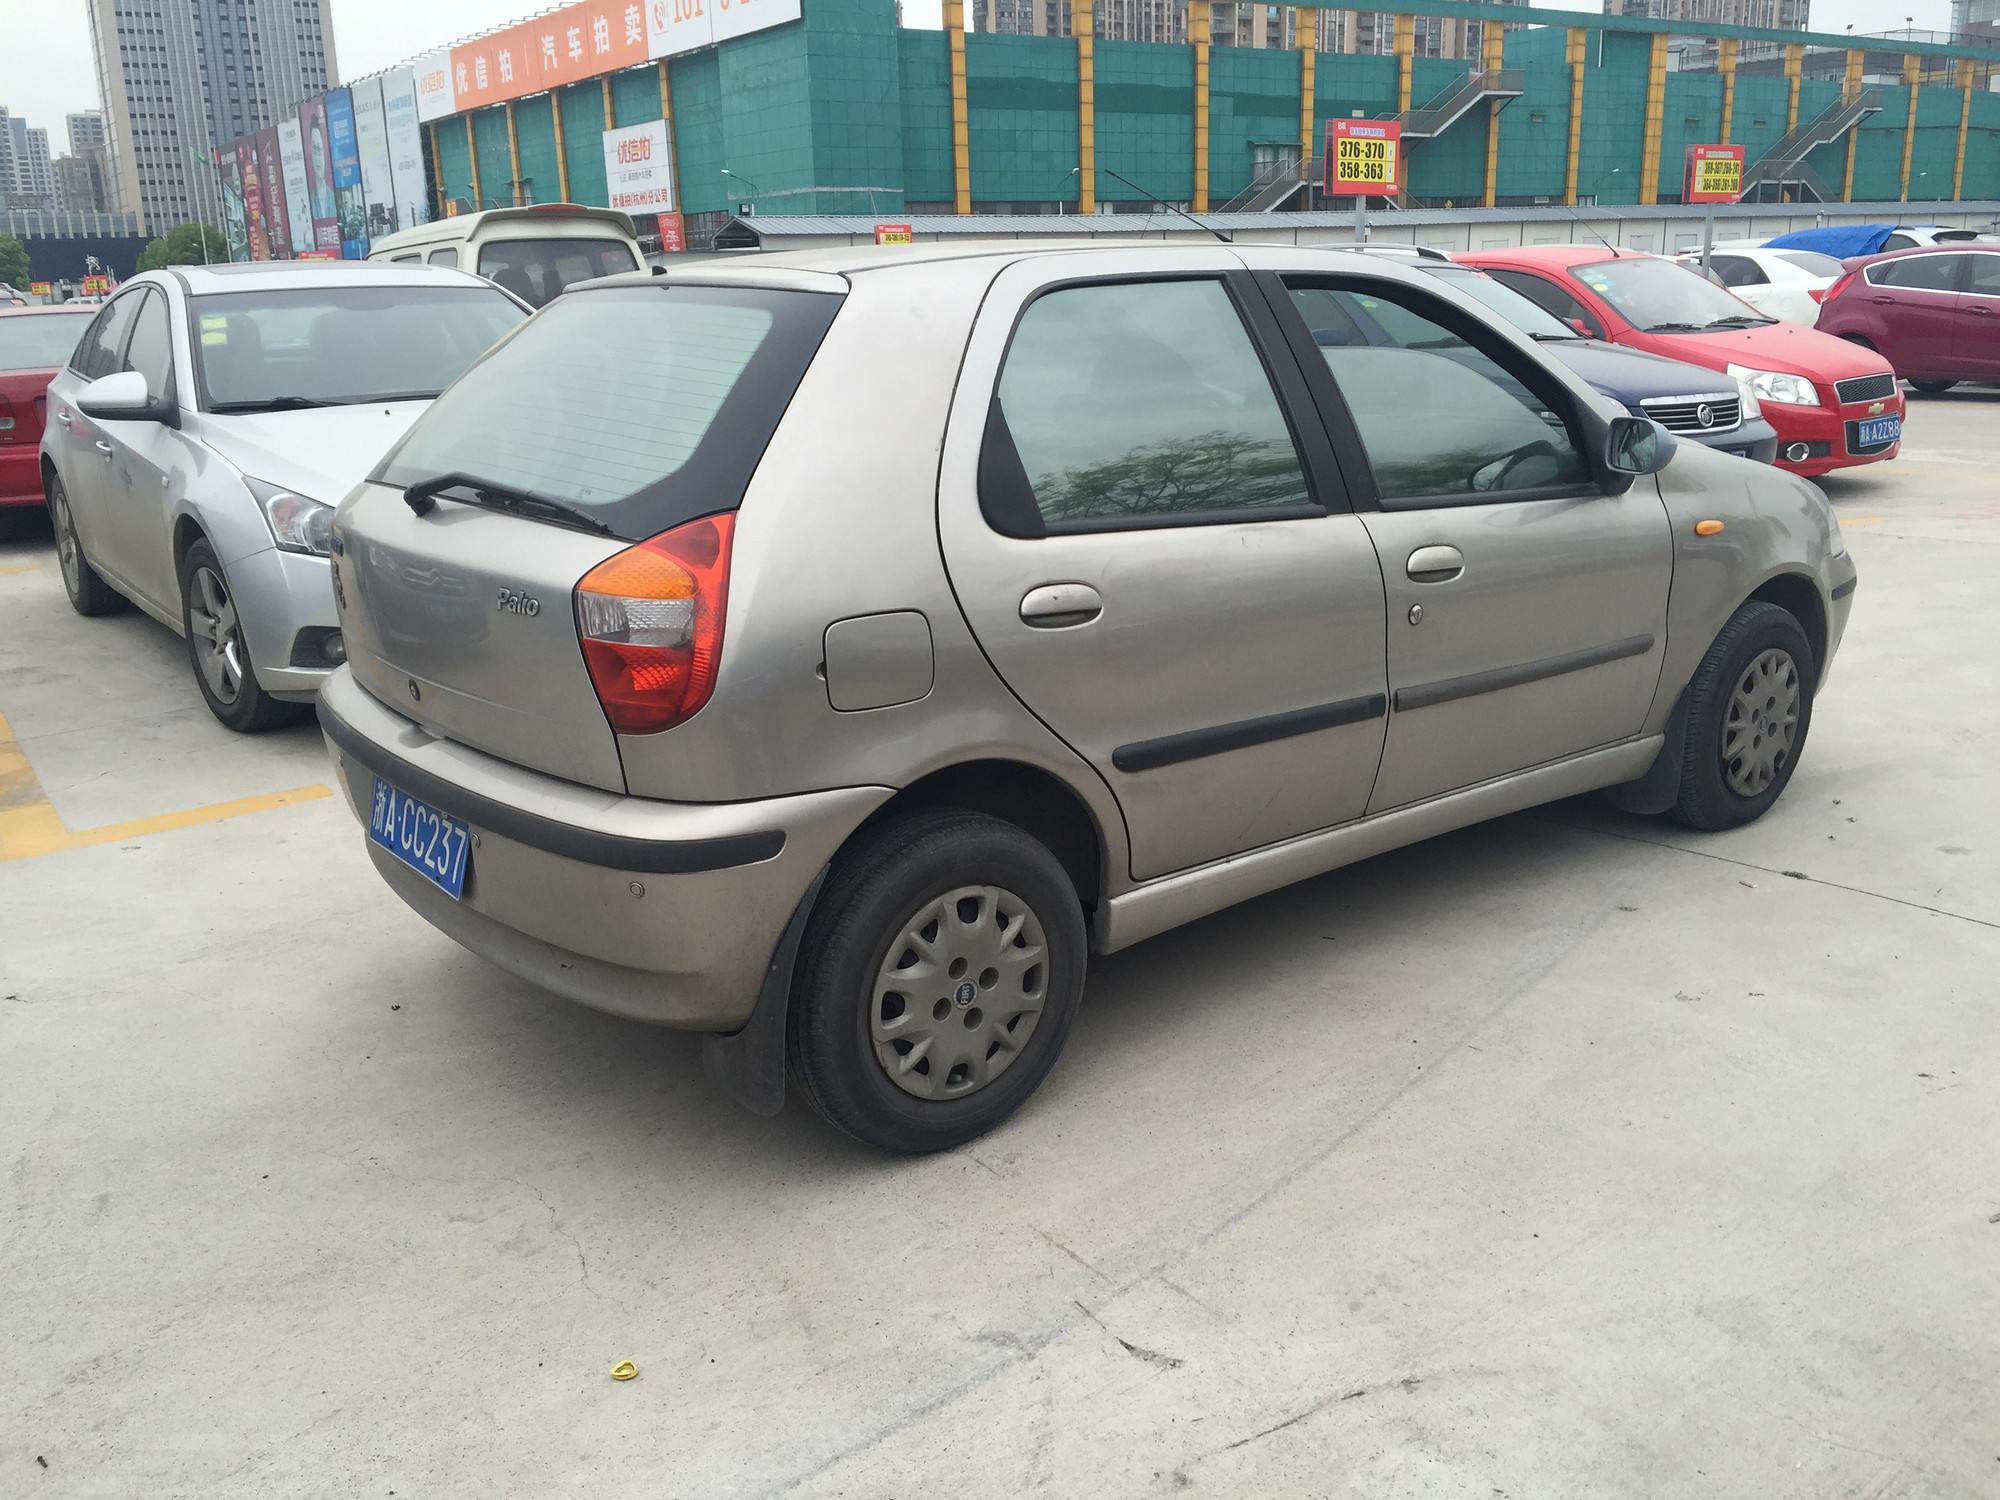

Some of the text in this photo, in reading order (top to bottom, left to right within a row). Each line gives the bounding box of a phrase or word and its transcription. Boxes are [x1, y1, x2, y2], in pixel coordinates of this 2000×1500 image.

[456, 4, 642, 95] 优信拍 汽车拍卖
[617, 136, 652, 165] 优信拍
[1340, 140, 1385, 159] 376-370
[1340, 161, 1383, 180] 358-363
[497, 587, 539, 616] Palio
[961, 985, 970, 1004] FIAT
